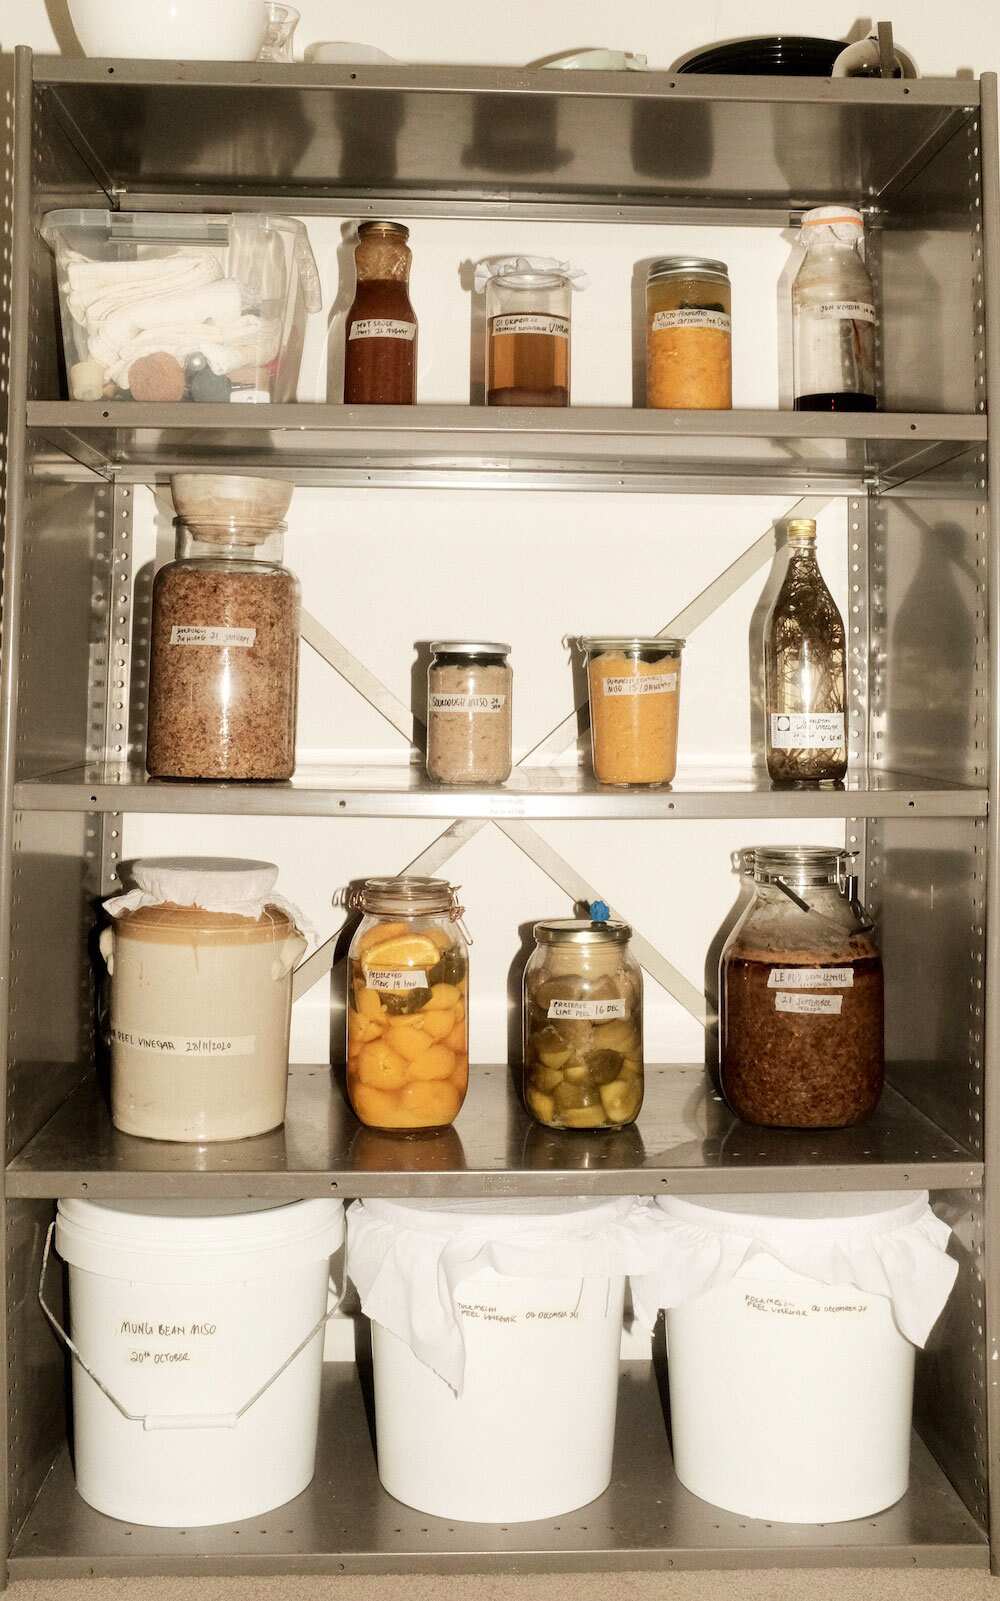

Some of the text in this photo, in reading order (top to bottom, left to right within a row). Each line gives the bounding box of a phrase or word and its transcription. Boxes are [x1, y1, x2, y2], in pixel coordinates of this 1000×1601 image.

[138, 1038, 177, 1051] VINEGAR
[120, 1321, 217, 1336] MUNG BEAN MISO
[153, 1351, 192, 1364] OCTOBER
